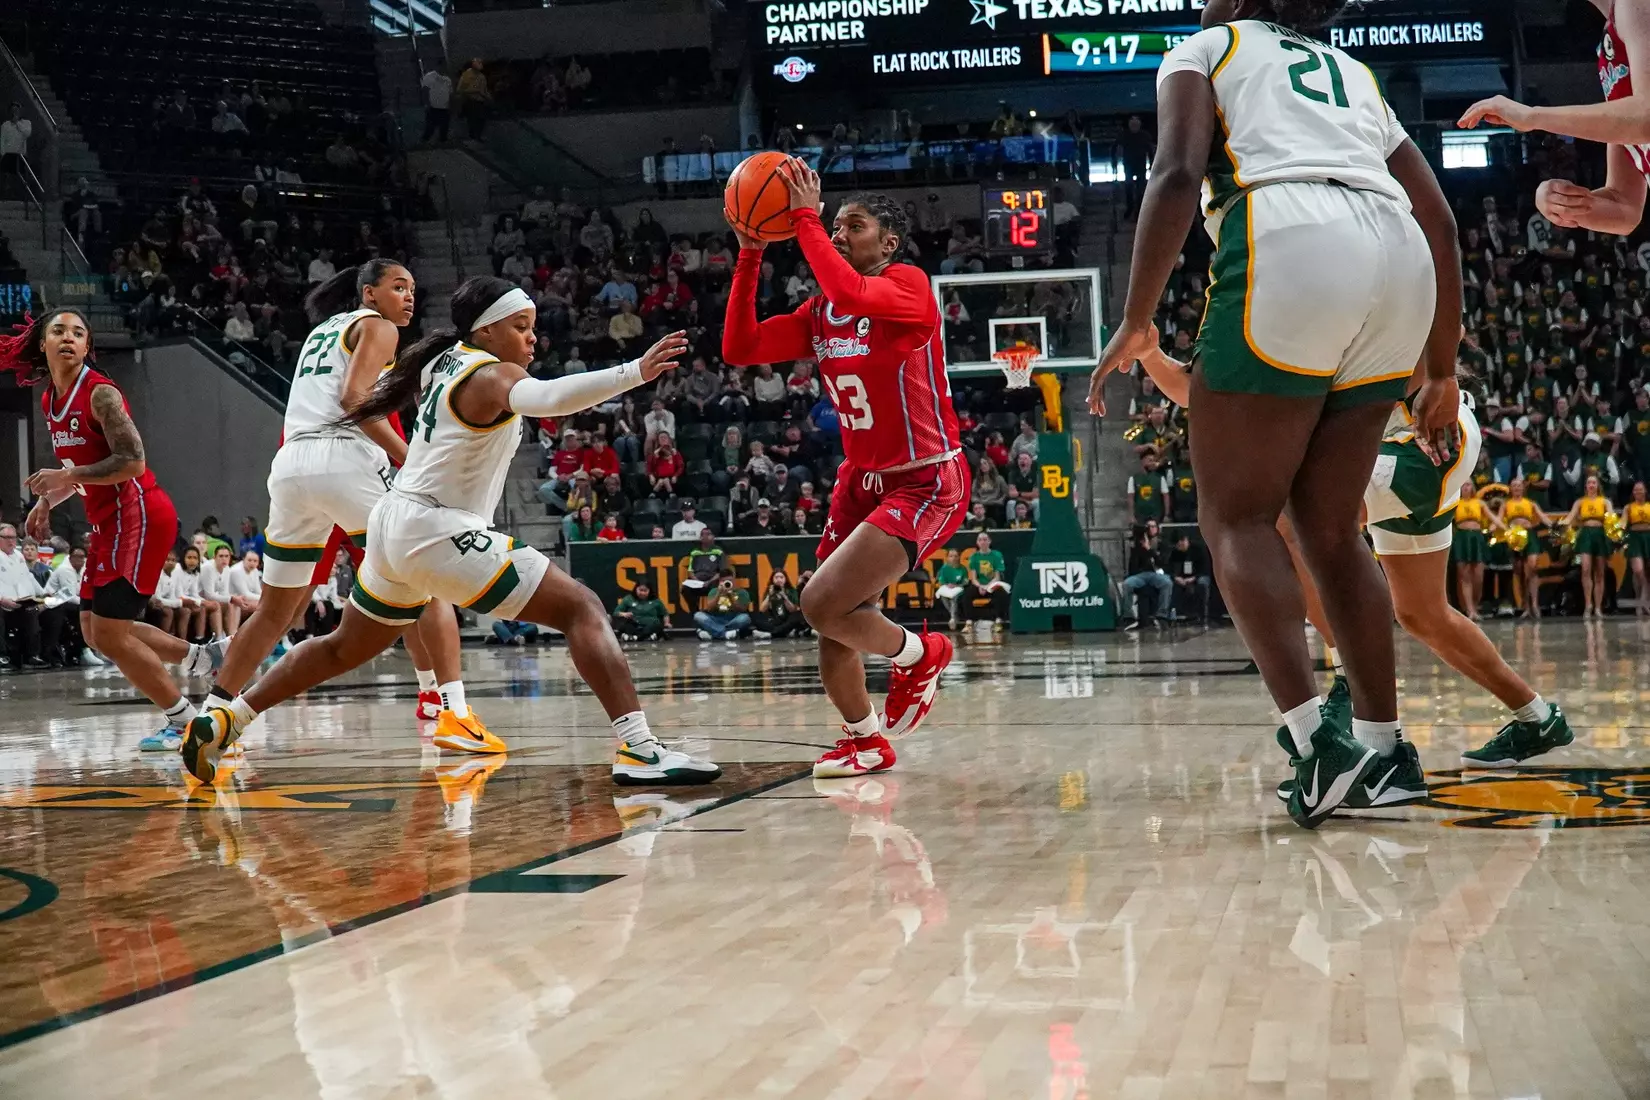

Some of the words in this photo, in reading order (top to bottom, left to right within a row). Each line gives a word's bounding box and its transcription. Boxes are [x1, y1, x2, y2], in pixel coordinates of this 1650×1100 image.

[766, 0, 929, 23] CHAMPIONSHIP
[1013, 0, 1103, 20] TEXAS
[1107, 0, 1184, 15] FARM
[766, 20, 865, 45] PARTNER
[1330, 27, 1365, 48] FLAT
[1369, 24, 1410, 46] ROCK
[1412, 21, 1484, 45] TRAILERS
[873, 53, 907, 74] FLAT
[910, 50, 950, 72] ROCK
[952, 46, 1021, 69] TRAILERS
[1071, 34, 1140, 66] 9:17
[1279, 39, 1350, 108] 21
[1001, 190, 1044, 210] 9:17
[1011, 211, 1039, 248] 12
[298, 330, 340, 379] 22
[1041, 465, 1069, 498] BU
[1019, 598, 1042, 608] Your
[1043, 597, 1068, 608] Bank
[1069, 596, 1085, 607] for
[1085, 595, 1104, 607] Life
